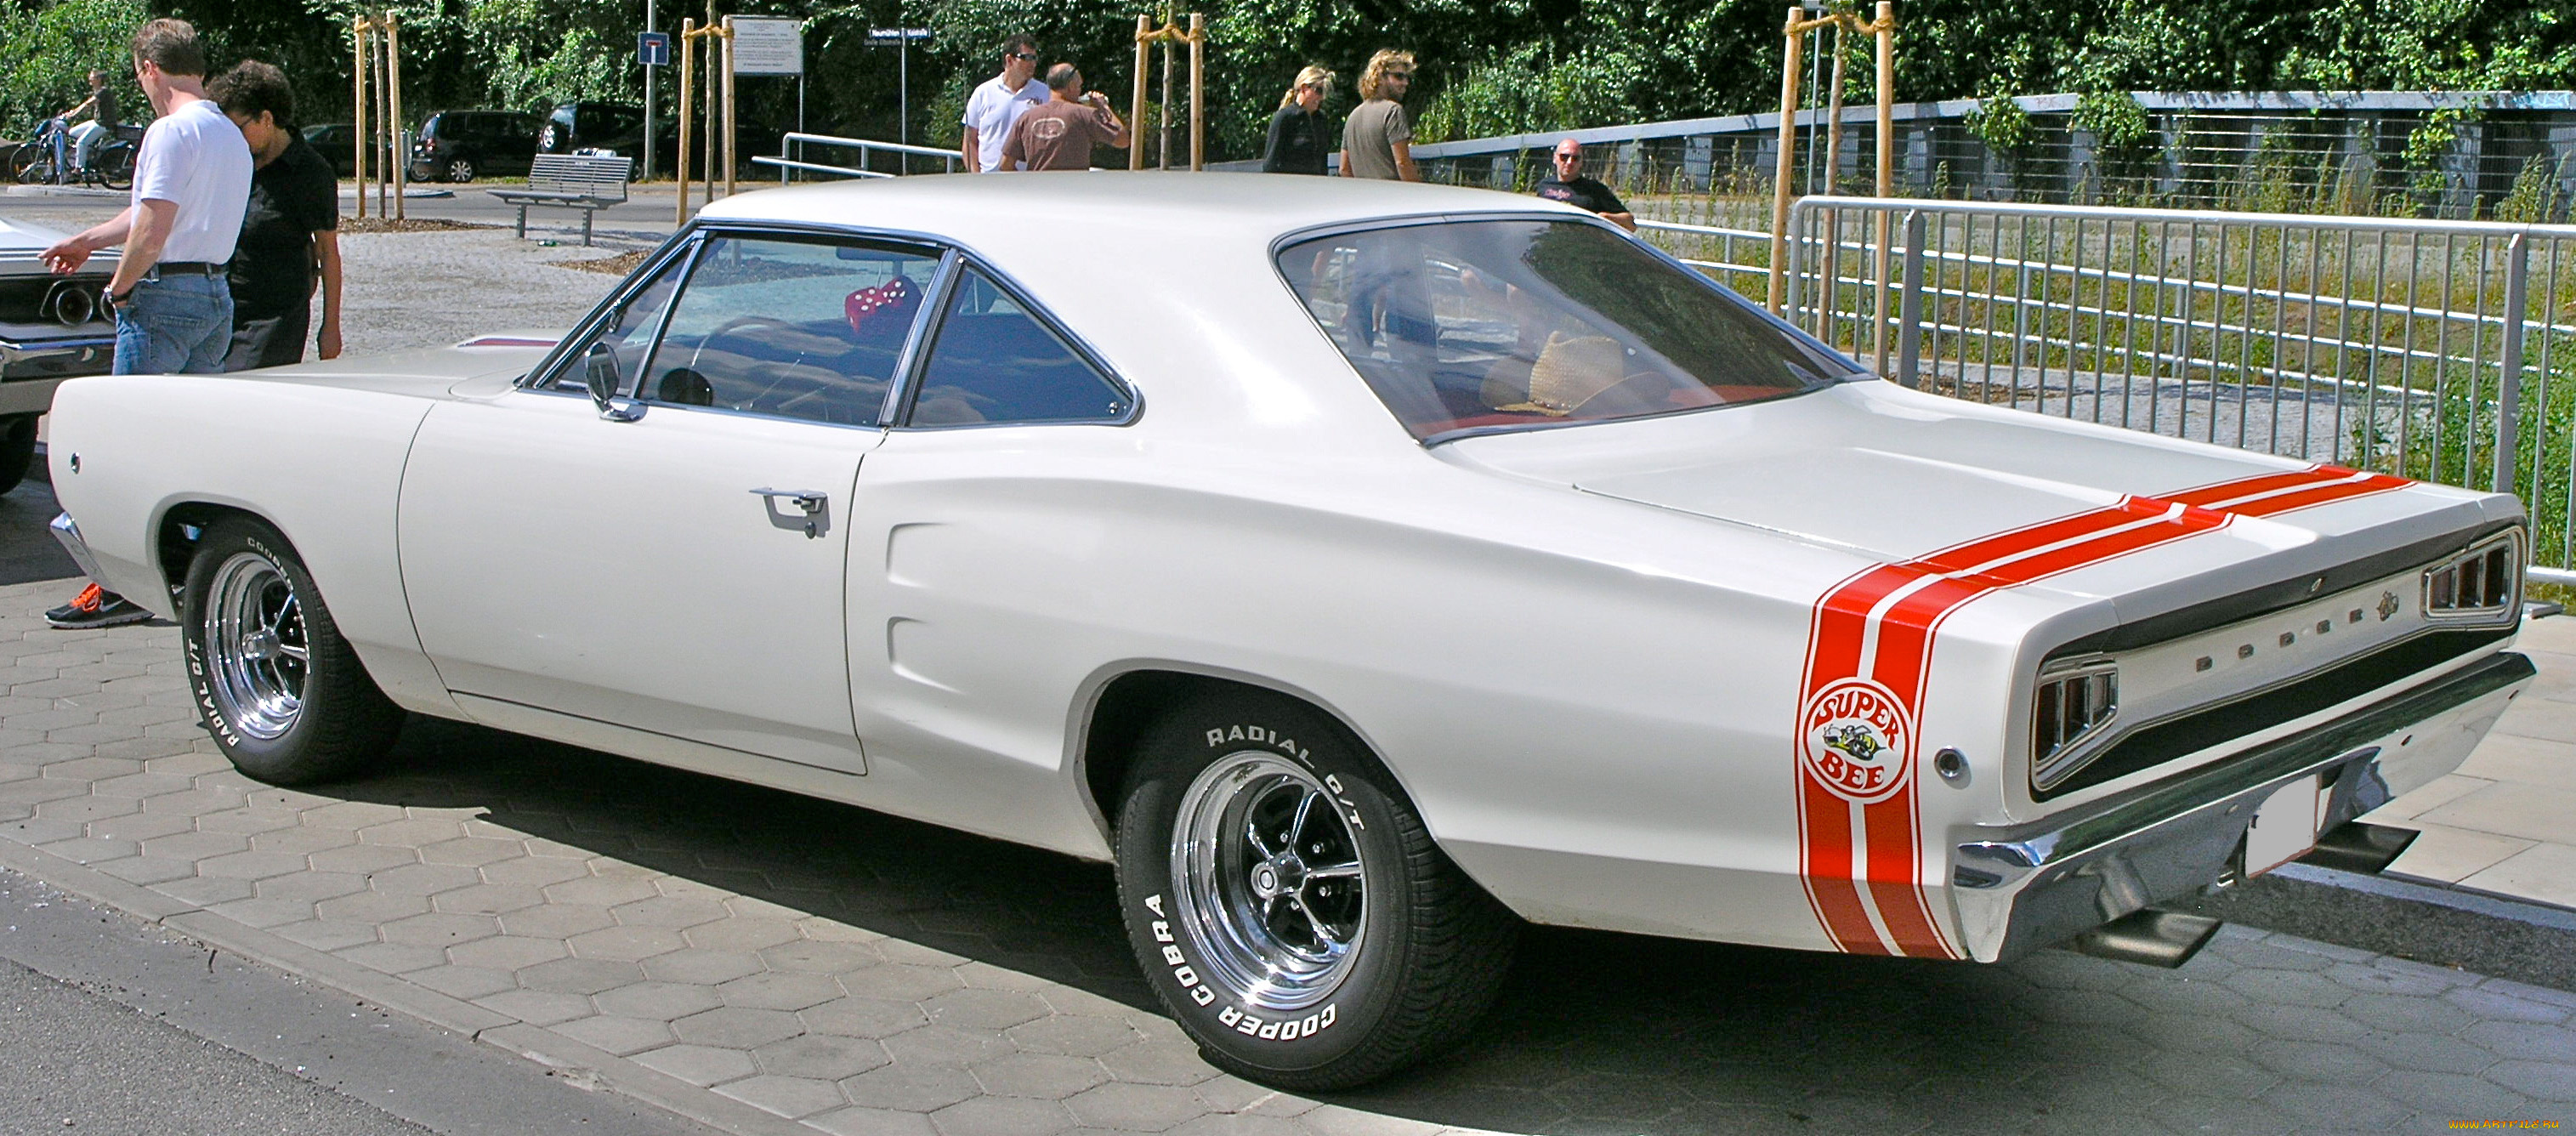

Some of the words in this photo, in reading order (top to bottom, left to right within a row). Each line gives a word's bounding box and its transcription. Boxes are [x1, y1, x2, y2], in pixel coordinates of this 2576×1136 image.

[188, 639, 204, 676] G/T
[2196, 608, 2363, 673] DODGE
[199, 682, 240, 747] RADIAL
[1813, 691, 1899, 751] SUPER
[1206, 725, 1315, 769] RADIAL
[1325, 774, 1365, 831] G/T
[1819, 749, 1885, 789] BEE
[1145, 895, 1216, 1007] COBRA
[1217, 1003, 1336, 1041] COOPER
